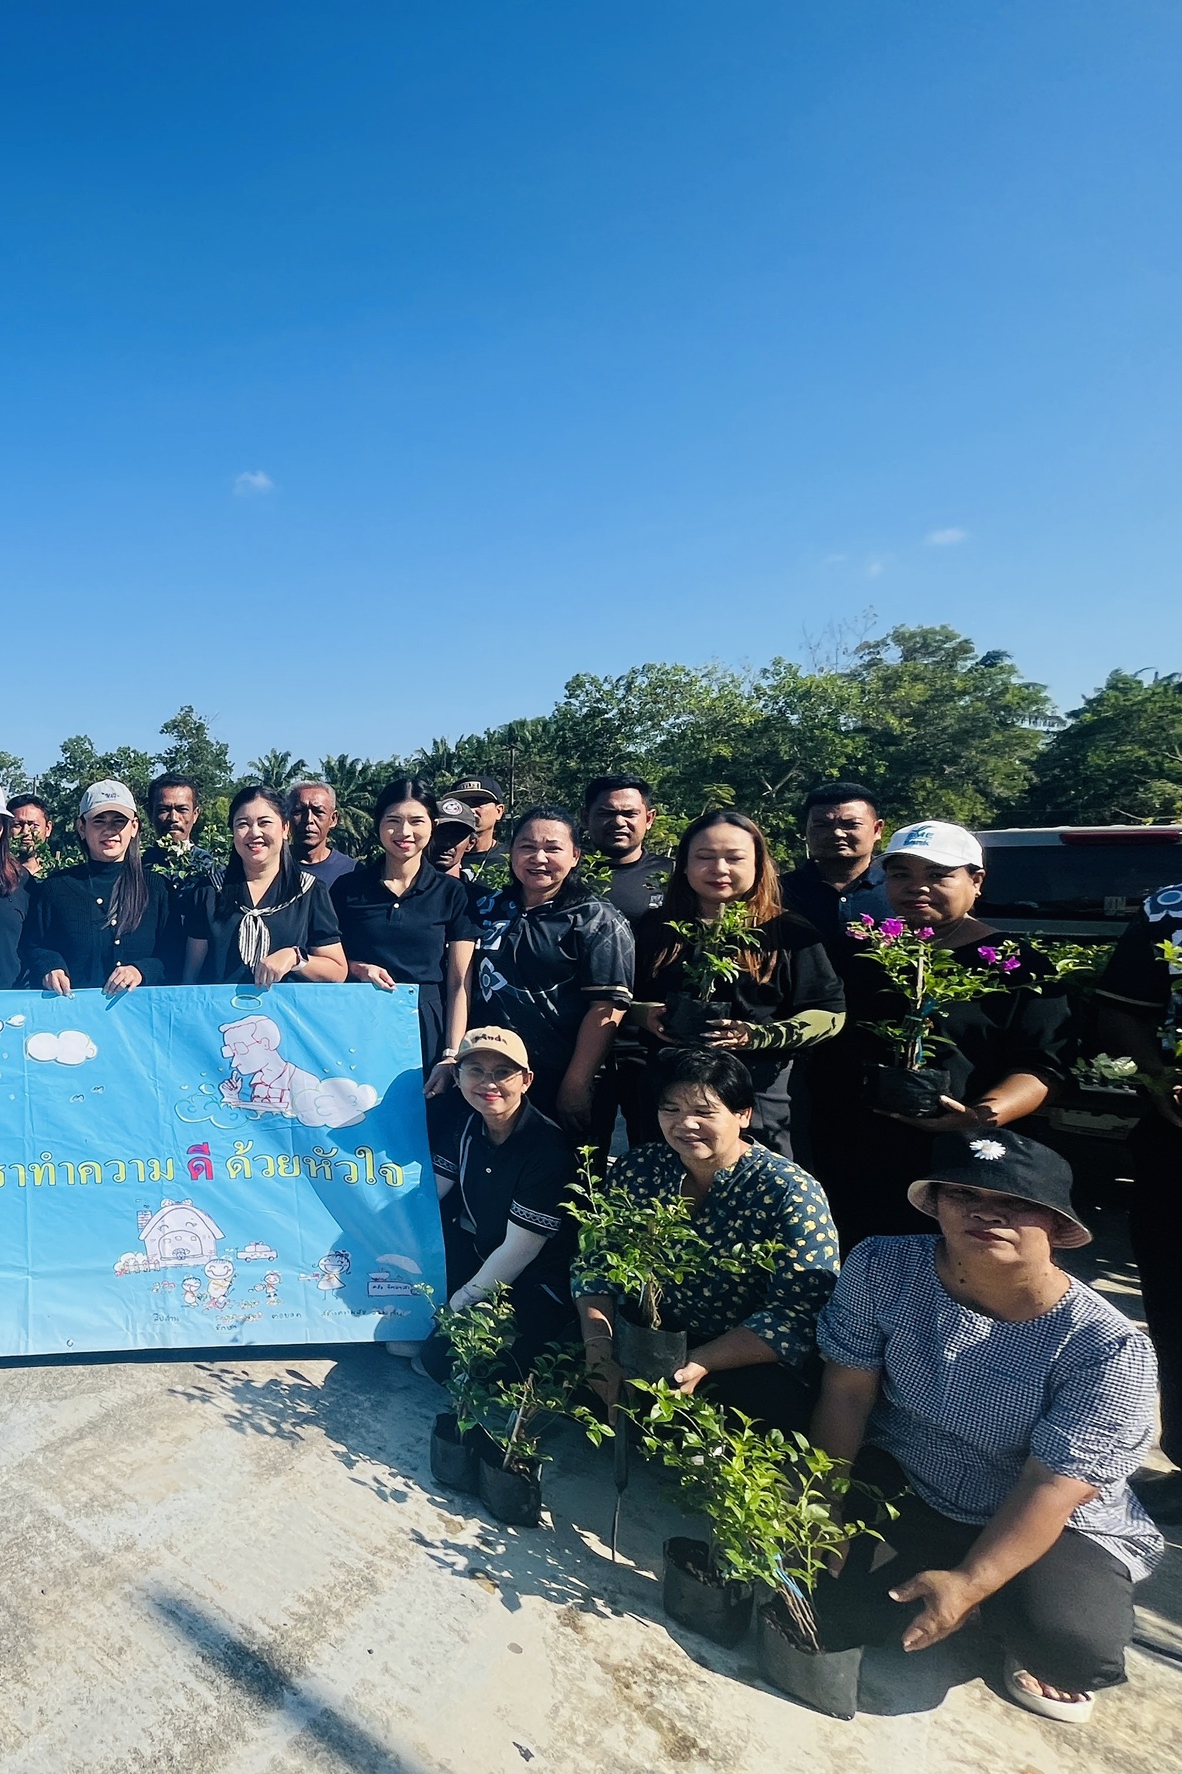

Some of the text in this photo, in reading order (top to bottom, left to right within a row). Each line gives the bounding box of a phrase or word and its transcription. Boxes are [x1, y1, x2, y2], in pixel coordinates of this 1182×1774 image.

[186, 1141, 215, 1181] ดี
[224, 1139, 406, 1188] ด้วยหัวใจ
